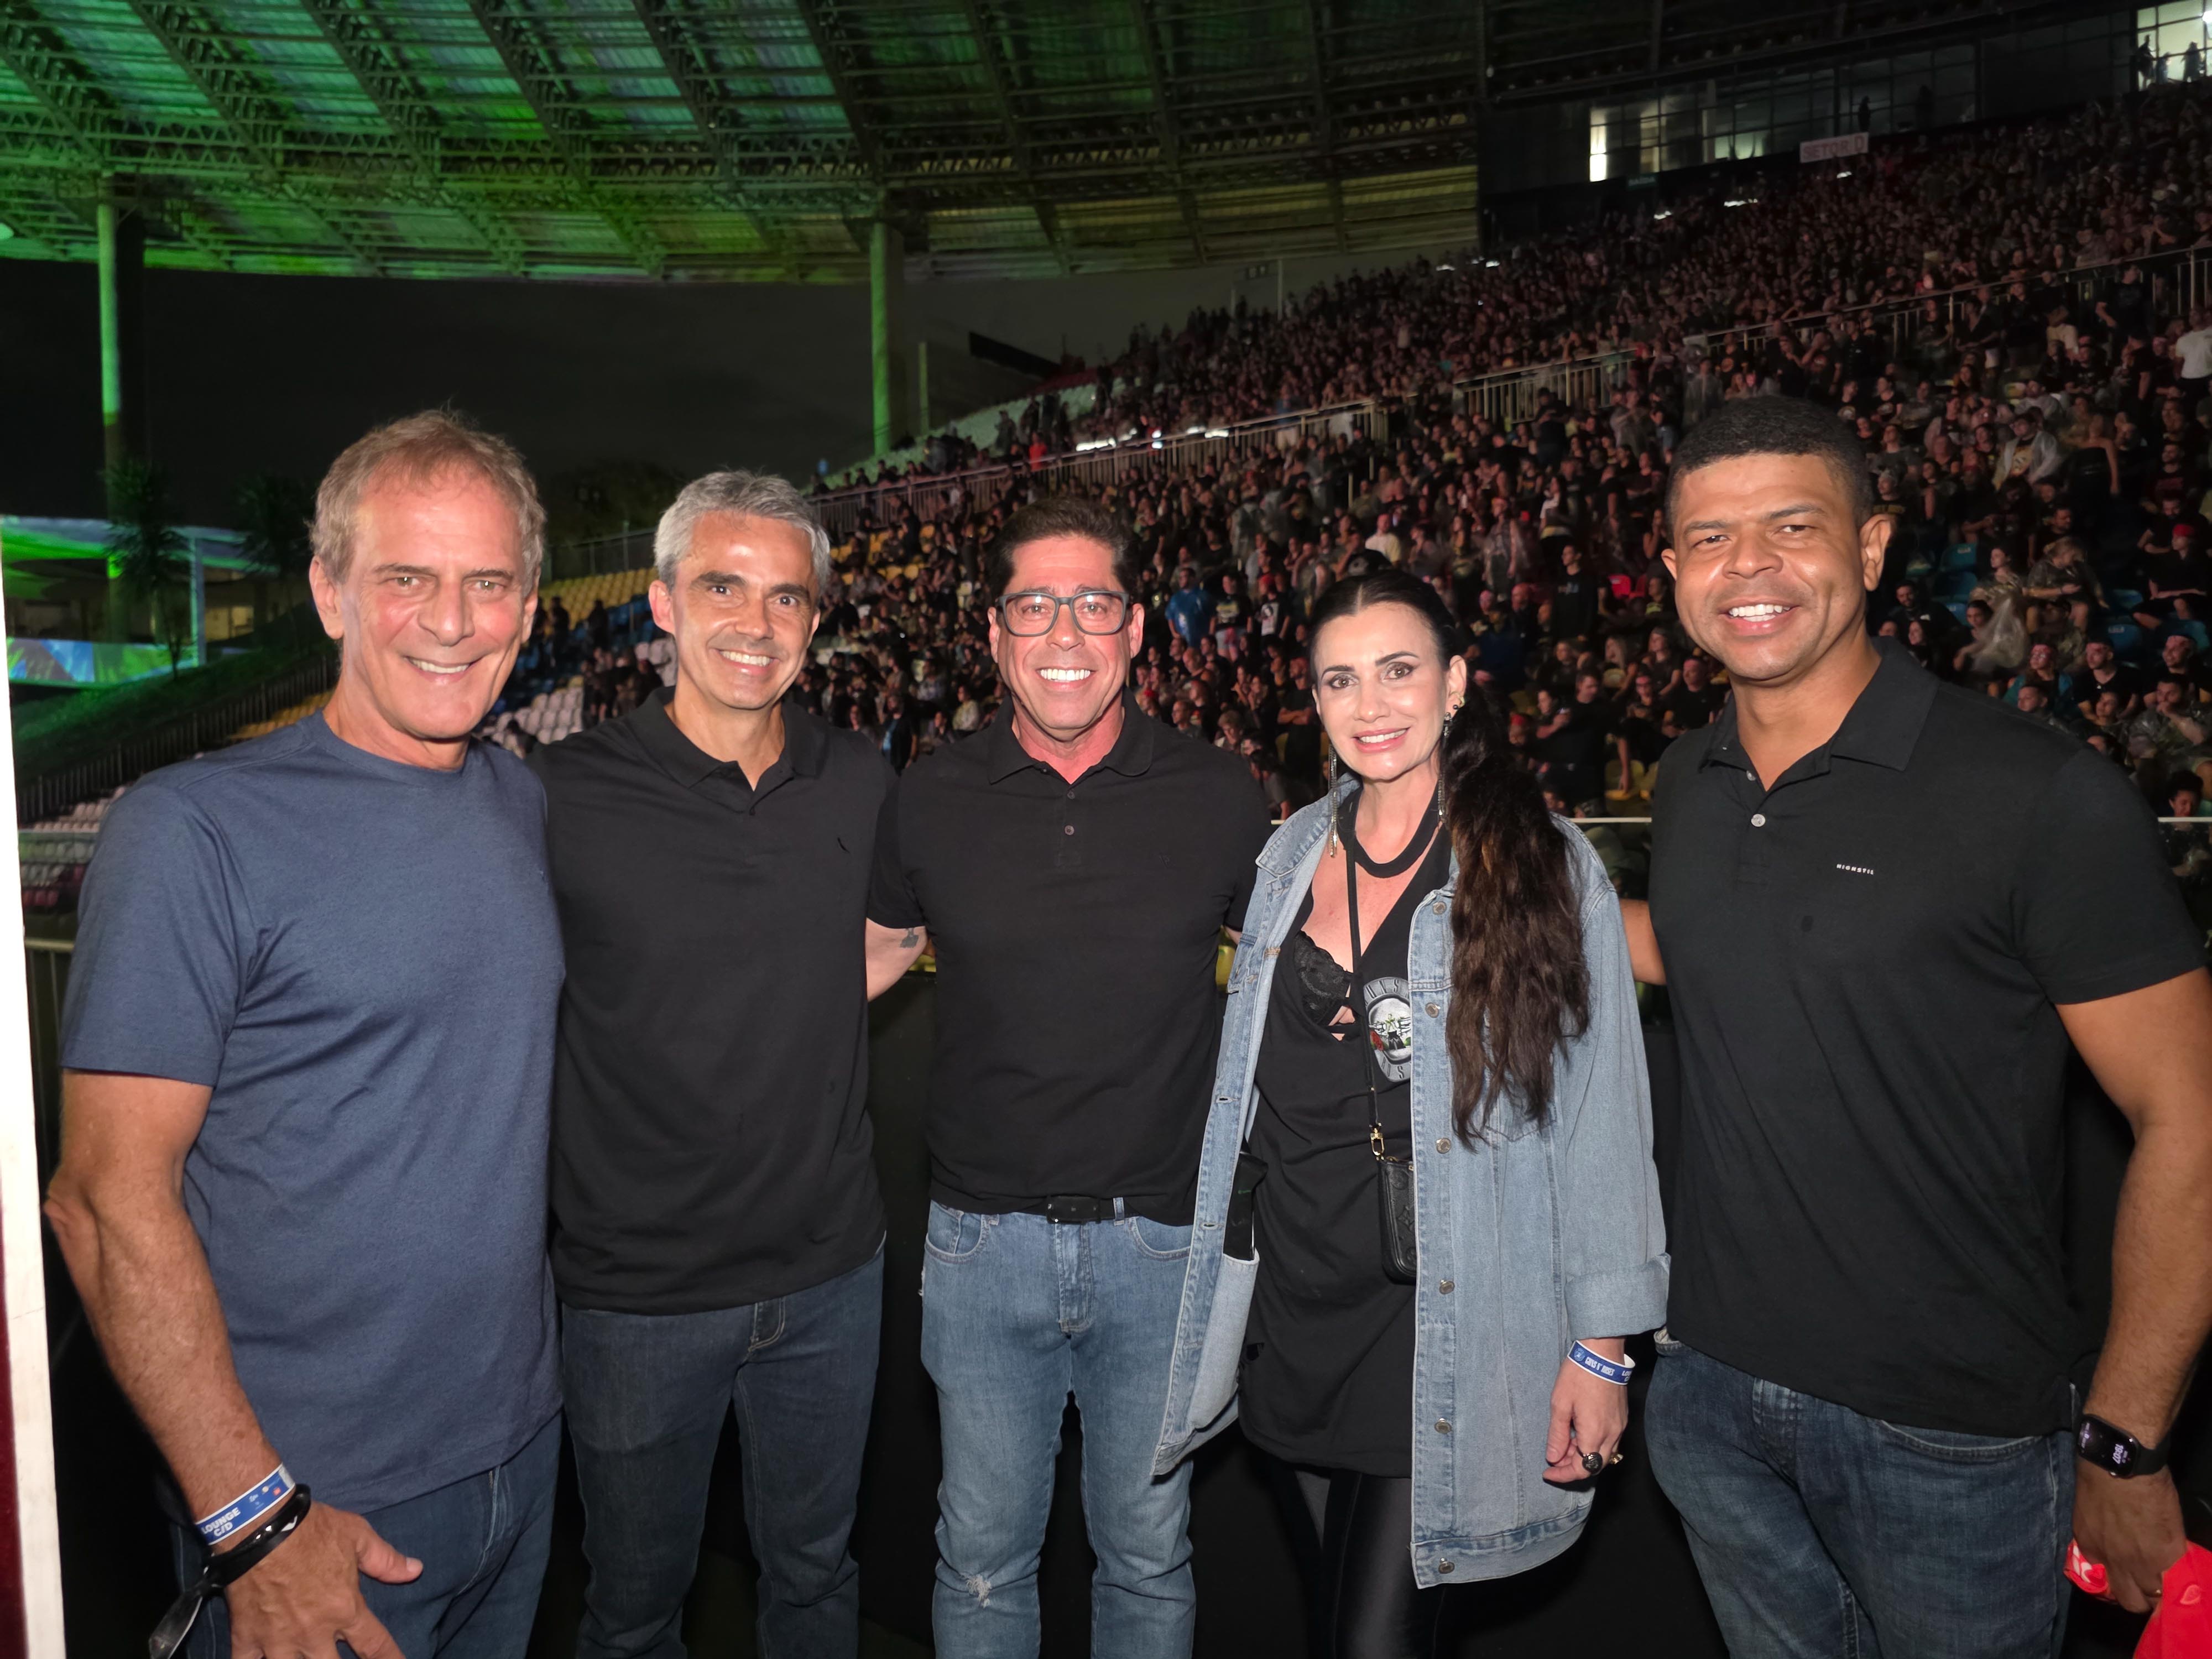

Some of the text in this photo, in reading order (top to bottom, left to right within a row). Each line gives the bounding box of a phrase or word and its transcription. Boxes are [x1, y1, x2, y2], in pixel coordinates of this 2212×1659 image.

[1803, 135, 1865, 160] SETOR D
[1365, 979, 1399, 1004] UNS
[2112, 1444, 2124, 1464] 19:07
[201, 1507, 241, 1534] LOUNGE
[213, 1522, 233, 1536] C/D
